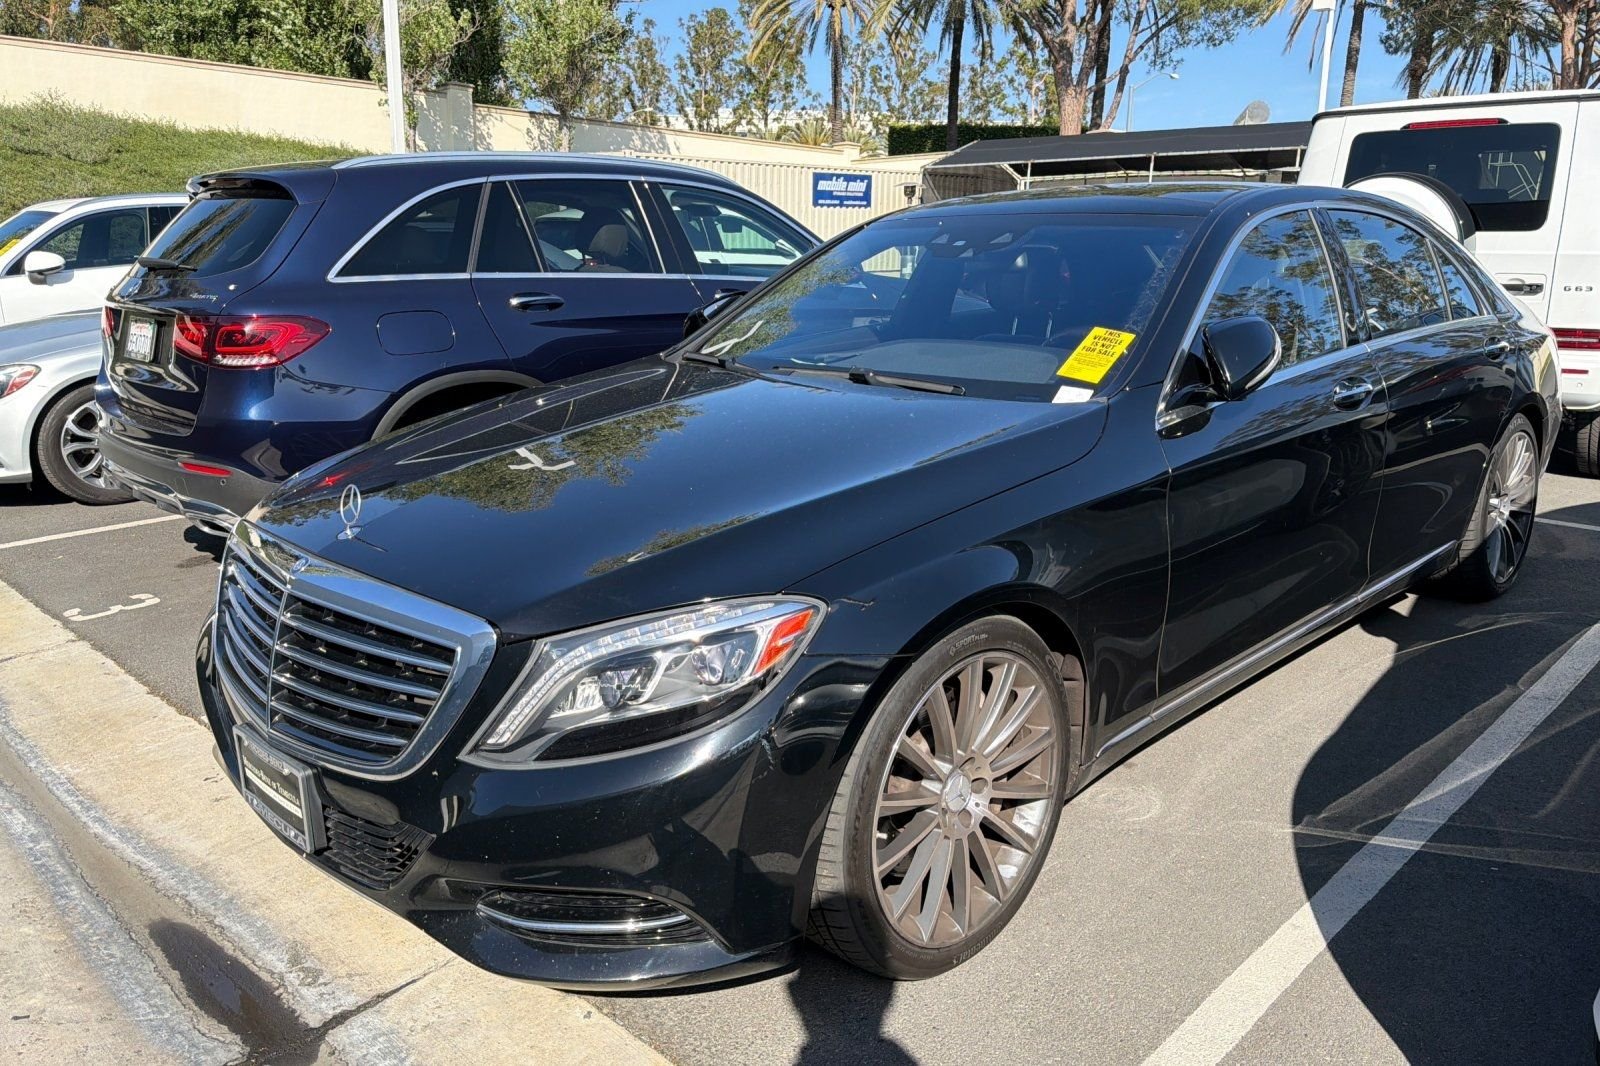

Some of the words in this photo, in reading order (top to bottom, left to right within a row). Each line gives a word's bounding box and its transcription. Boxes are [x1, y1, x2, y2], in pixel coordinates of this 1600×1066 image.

[817, 176, 847, 191] mobile
[847, 179, 868, 192] mini
[1104, 330, 1121, 338] THIS
[1093, 335, 1124, 346] VEHICLE
[1101, 342, 1115, 350] NOT
[1081, 345, 1097, 353] FOR
[1097, 349, 1117, 358] SALE
[245, 790, 307, 850] TEMECULA
